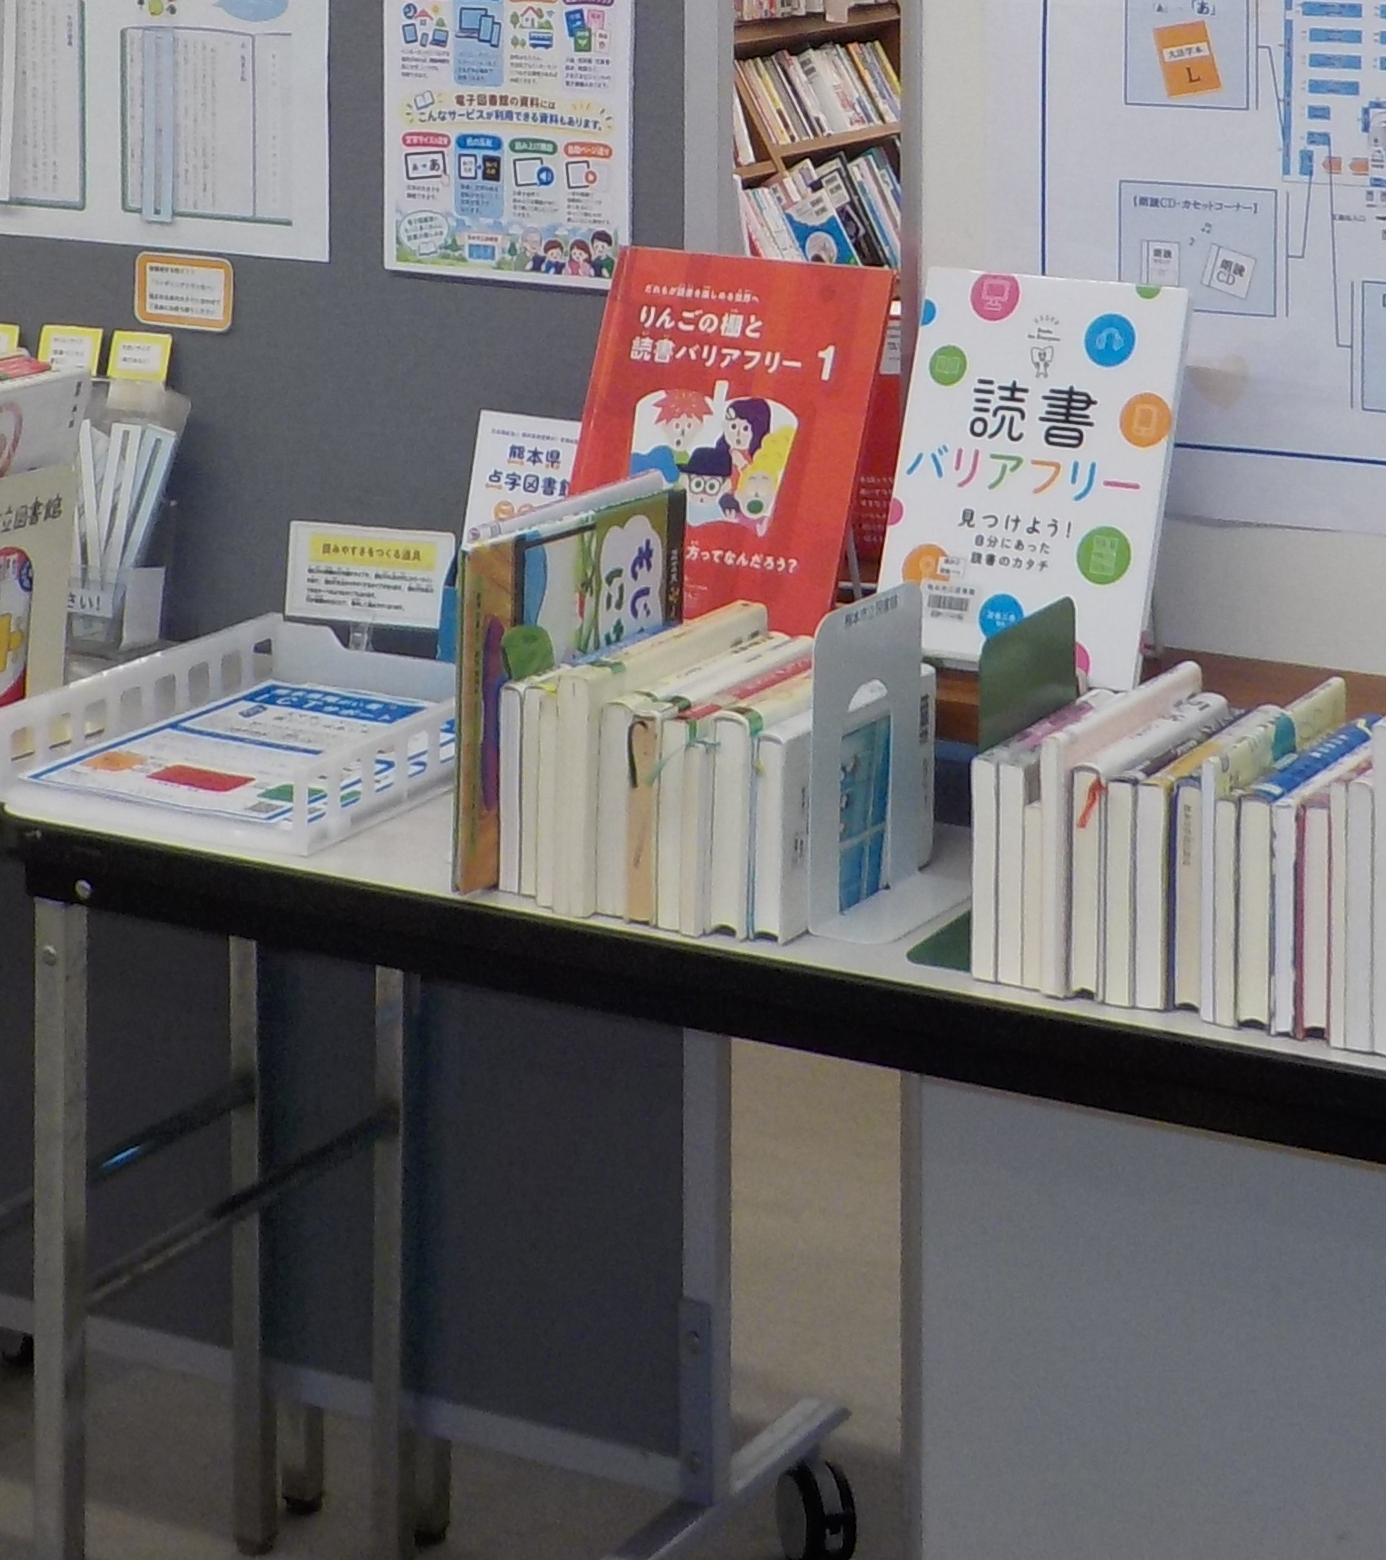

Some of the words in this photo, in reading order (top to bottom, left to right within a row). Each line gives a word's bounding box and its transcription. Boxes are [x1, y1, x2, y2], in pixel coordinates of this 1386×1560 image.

[1185, 66, 1202, 84] L
[454, 94, 556, 110] 電子図書館の資料には
[418, 108, 603, 132] こんなサービスが利用できる資料もあります。
[429, 158, 441, 173] あ
[1215, 271, 1236, 287] CD
[639, 305, 763, 339] りんごの棚と
[630, 335, 803, 375] 読書バリアフリー
[817, 345, 836, 382] 1
[969, 378, 1098, 449] 読書
[509, 443, 562, 471] 熊本県
[905, 444, 1141, 502] バリアフリー
[957, 507, 1073, 539] 見つけよう!
[973, 534, 1051, 555] 自分にあった
[970, 551, 1050, 573] 読書のカタチ
